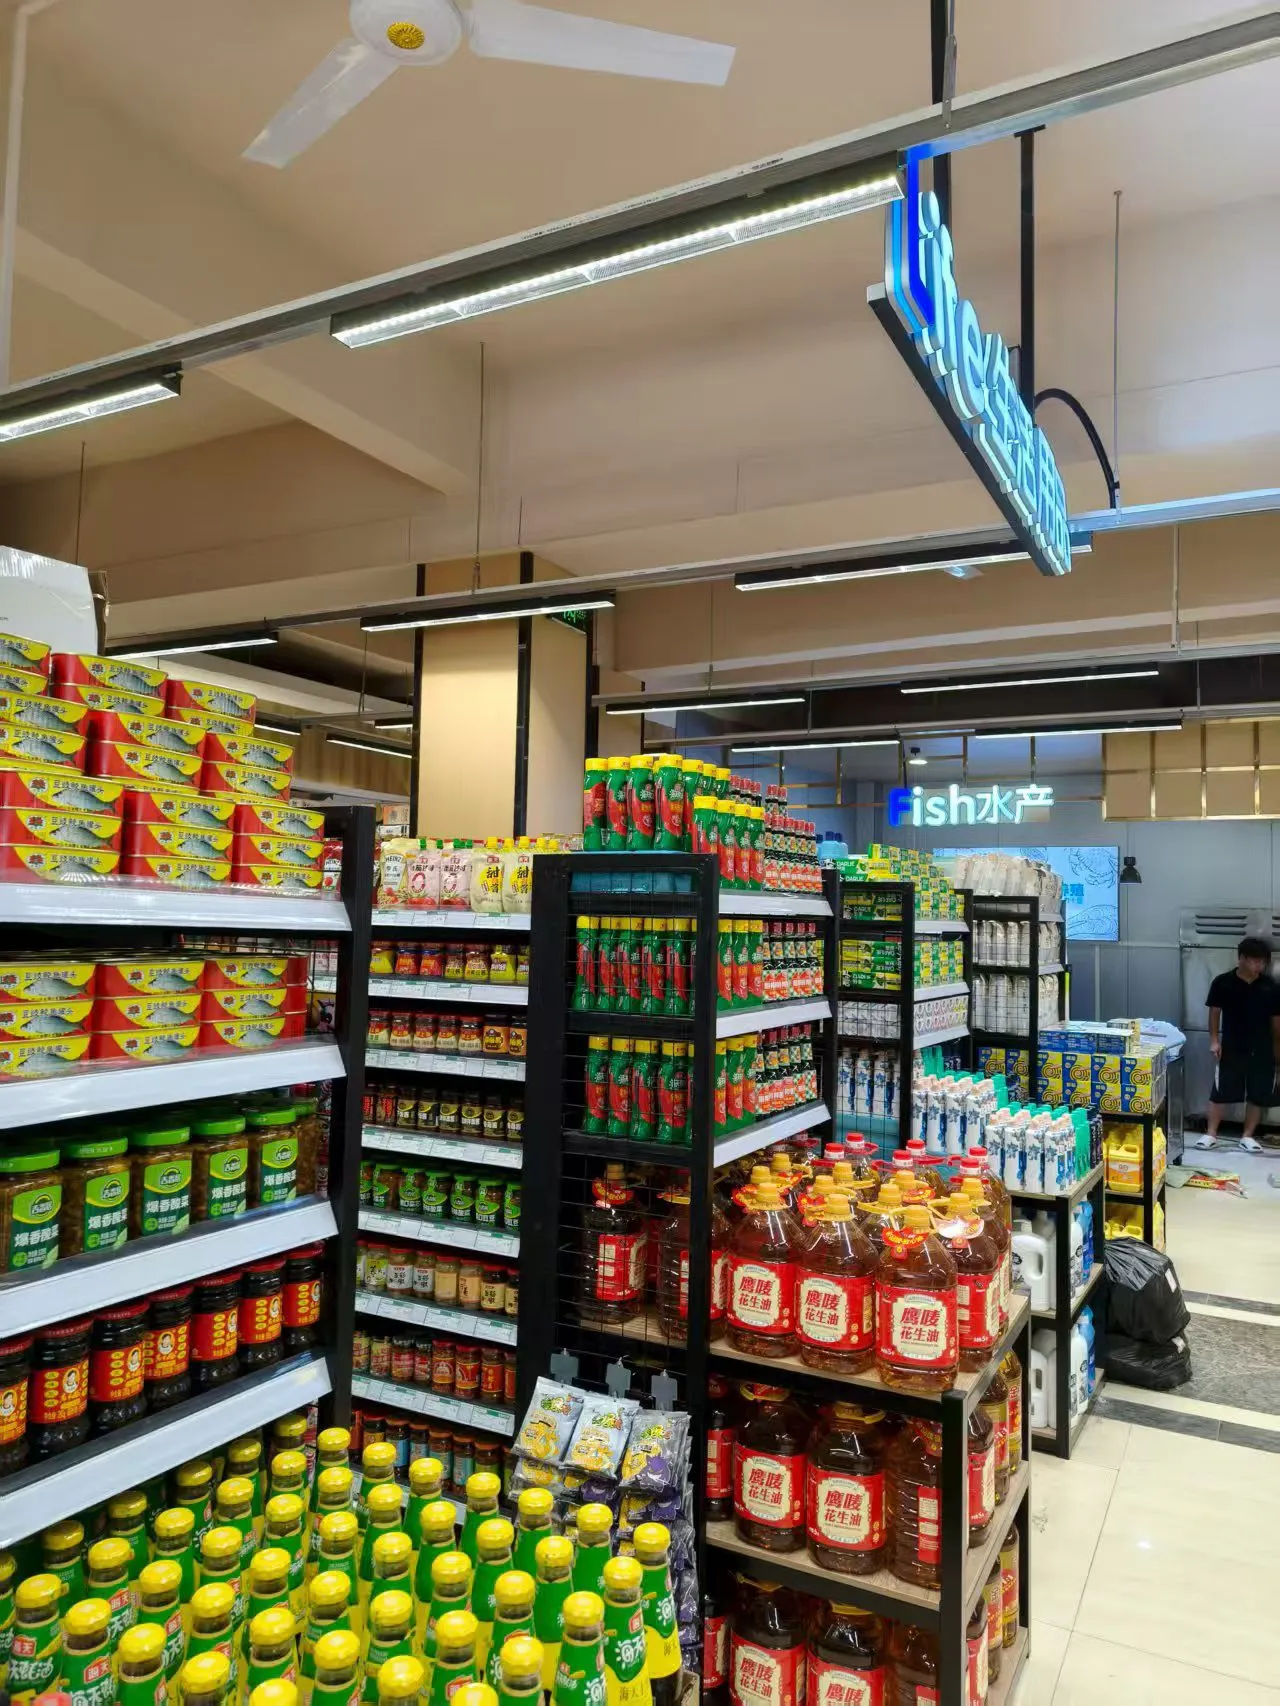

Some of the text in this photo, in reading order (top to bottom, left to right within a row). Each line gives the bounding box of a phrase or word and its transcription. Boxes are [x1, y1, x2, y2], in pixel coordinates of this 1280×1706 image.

[888, 783, 1055, 827] Fish水产
[740, 1275, 773, 1297] 鹰唛
[738, 1292, 772, 1311] 花生油
[805, 1289, 840, 1311] 鹰唛
[805, 1307, 840, 1326] 花生油
[901, 1307, 940, 1327] 鹰唛
[900, 1325, 940, 1343] 花生油
[749, 1468, 785, 1491] 鹰唛
[748, 1485, 783, 1505] 花生油
[824, 1490, 863, 1512] 鹰唛
[824, 1508, 862, 1528] 花生油
[740, 1657, 774, 1682] 鹰唛
[739, 1673, 773, 1698] 花生油
